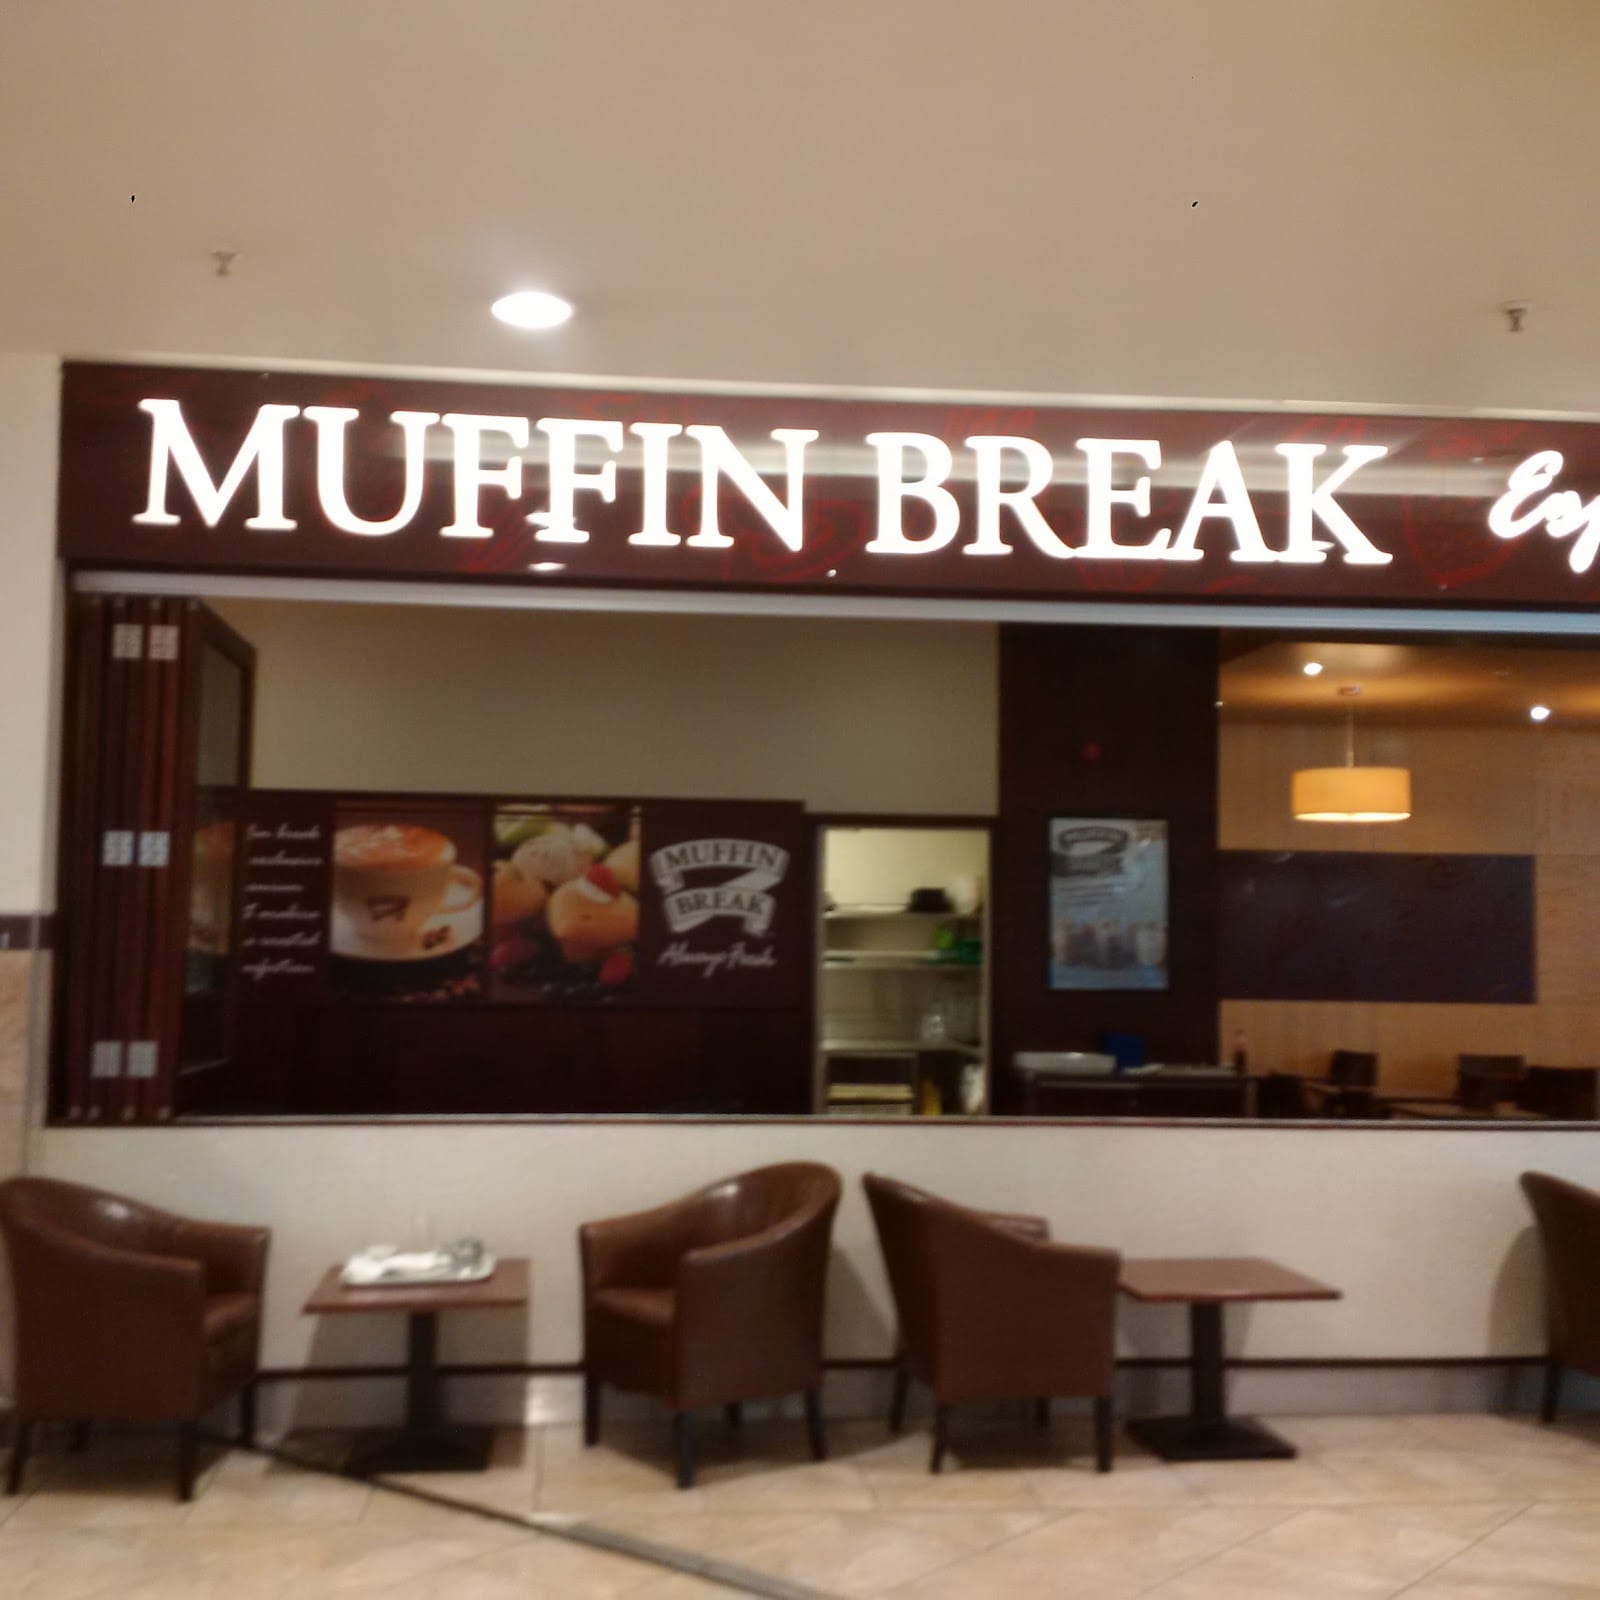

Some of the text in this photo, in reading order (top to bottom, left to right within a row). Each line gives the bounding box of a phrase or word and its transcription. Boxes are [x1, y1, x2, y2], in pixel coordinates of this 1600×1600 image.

[132, 397, 820, 552] MUFFIN
[864, 431, 1394, 564] BREAK
[664, 843, 779, 868] MUFFIN
[676, 892, 763, 915] BREAK
